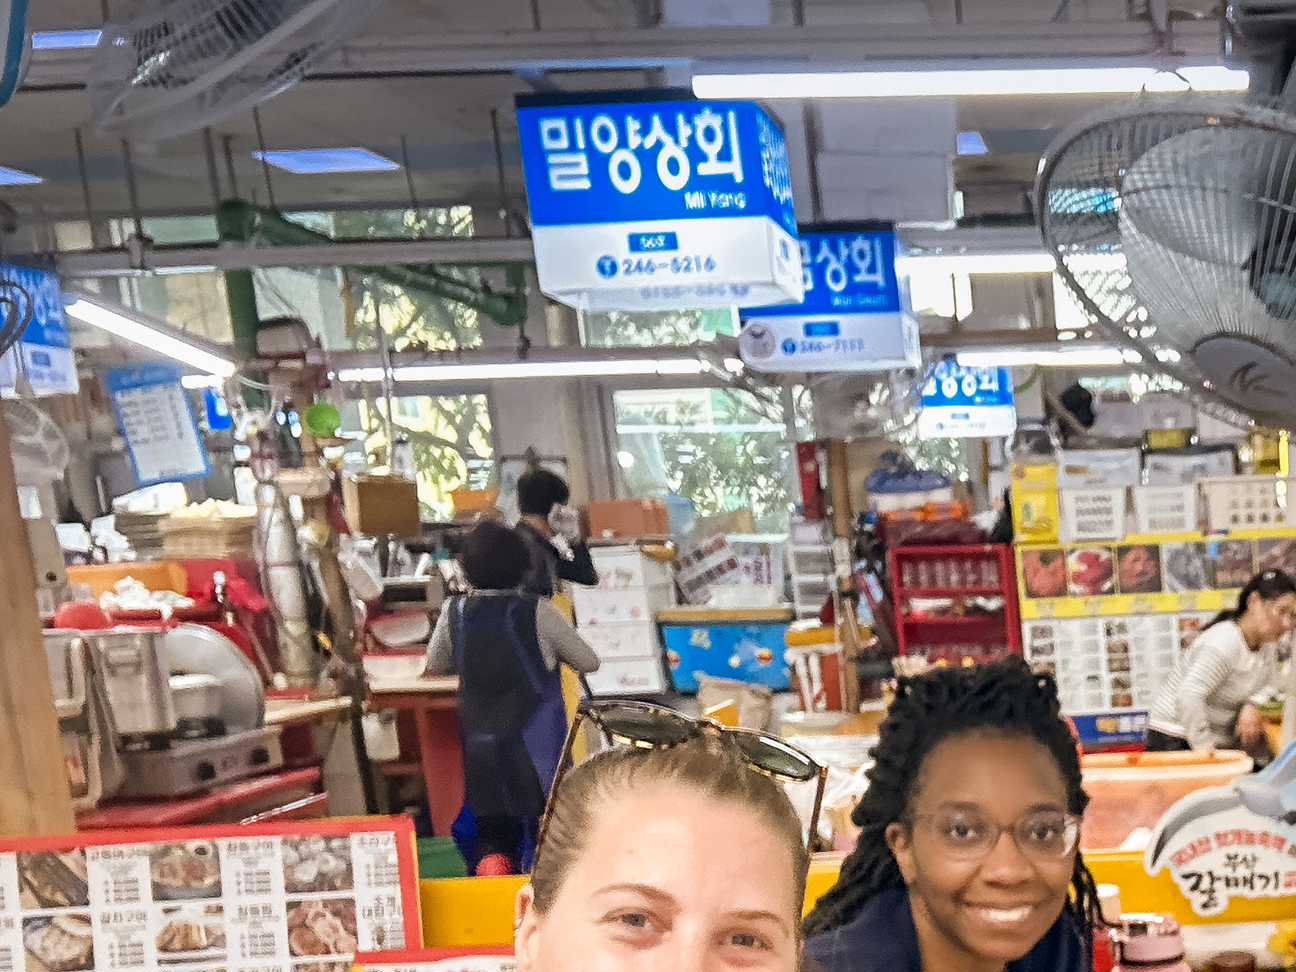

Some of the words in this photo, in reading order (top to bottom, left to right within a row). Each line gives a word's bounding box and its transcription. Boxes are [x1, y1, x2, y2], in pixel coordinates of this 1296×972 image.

[538, 107, 744, 193] 밀양상회
[800, 235, 886, 293] 상회
[1181, 869, 1280, 910] 갈매기
